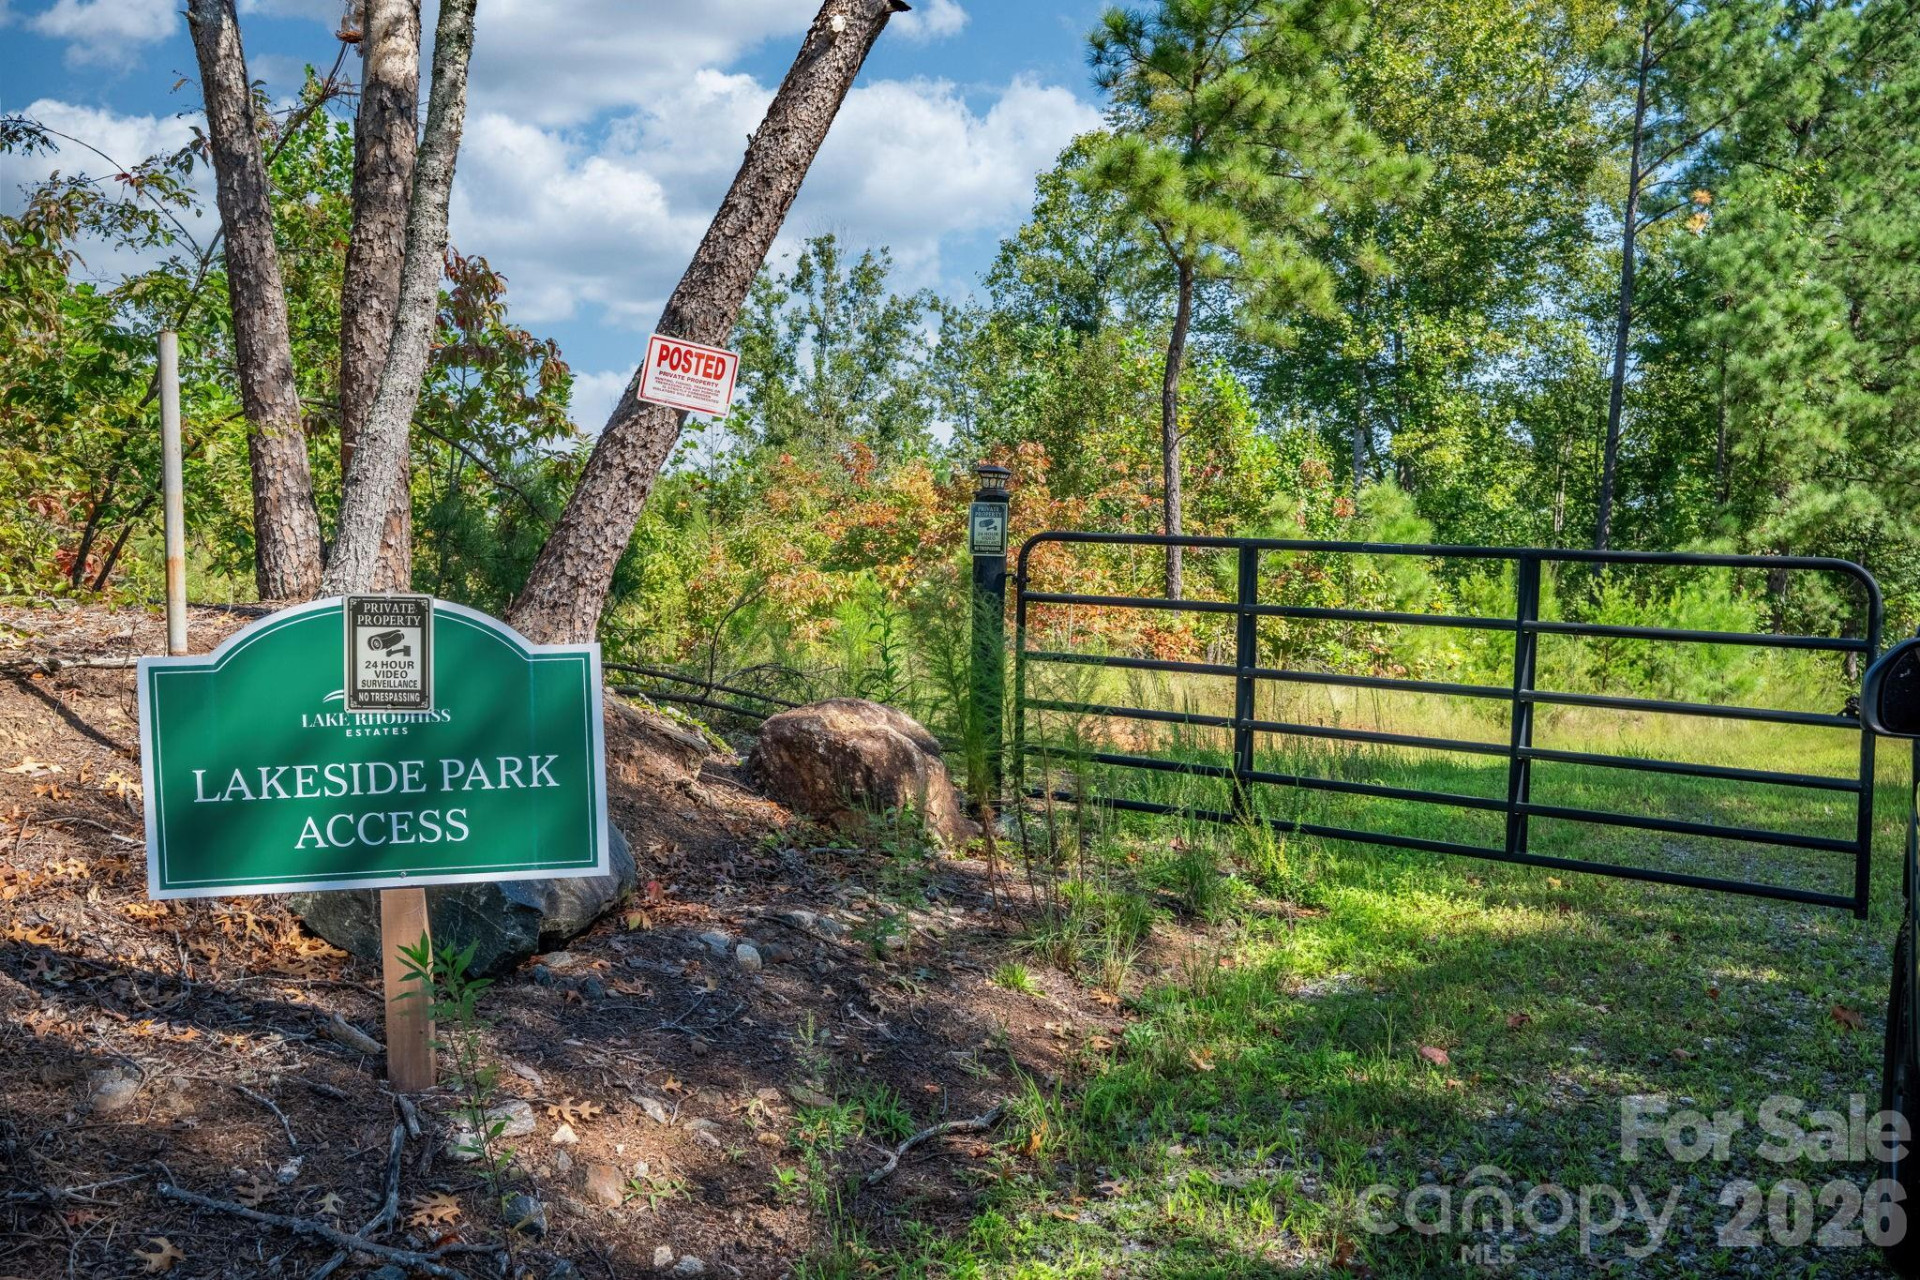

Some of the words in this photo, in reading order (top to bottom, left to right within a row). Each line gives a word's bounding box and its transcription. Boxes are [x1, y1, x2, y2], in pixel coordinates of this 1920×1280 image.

[656, 344, 726, 380] POSTED
[659, 371, 685, 381] PRIVATE
[687, 376, 719, 388] PROPERTY
[364, 602, 416, 614] PRIVATE
[357, 615, 421, 626] PROPERTY
[365, 661, 378, 669] 24
[381, 661, 414, 669] HOUR
[374, 670, 408, 678] VIDEO
[361, 680, 418, 688] SURVEILLANCE
[359, 692, 369, 702] NO
[371, 692, 420, 702] TRESPASSING
[302, 712, 350, 728] LAKE
[356, 709, 451, 725] RHODHISS
[346, 728, 408, 736] ESTATES
[192, 760, 427, 803] LAKESIDE
[439, 754, 560, 792] PARK
[294, 809, 470, 849] ACCESS
